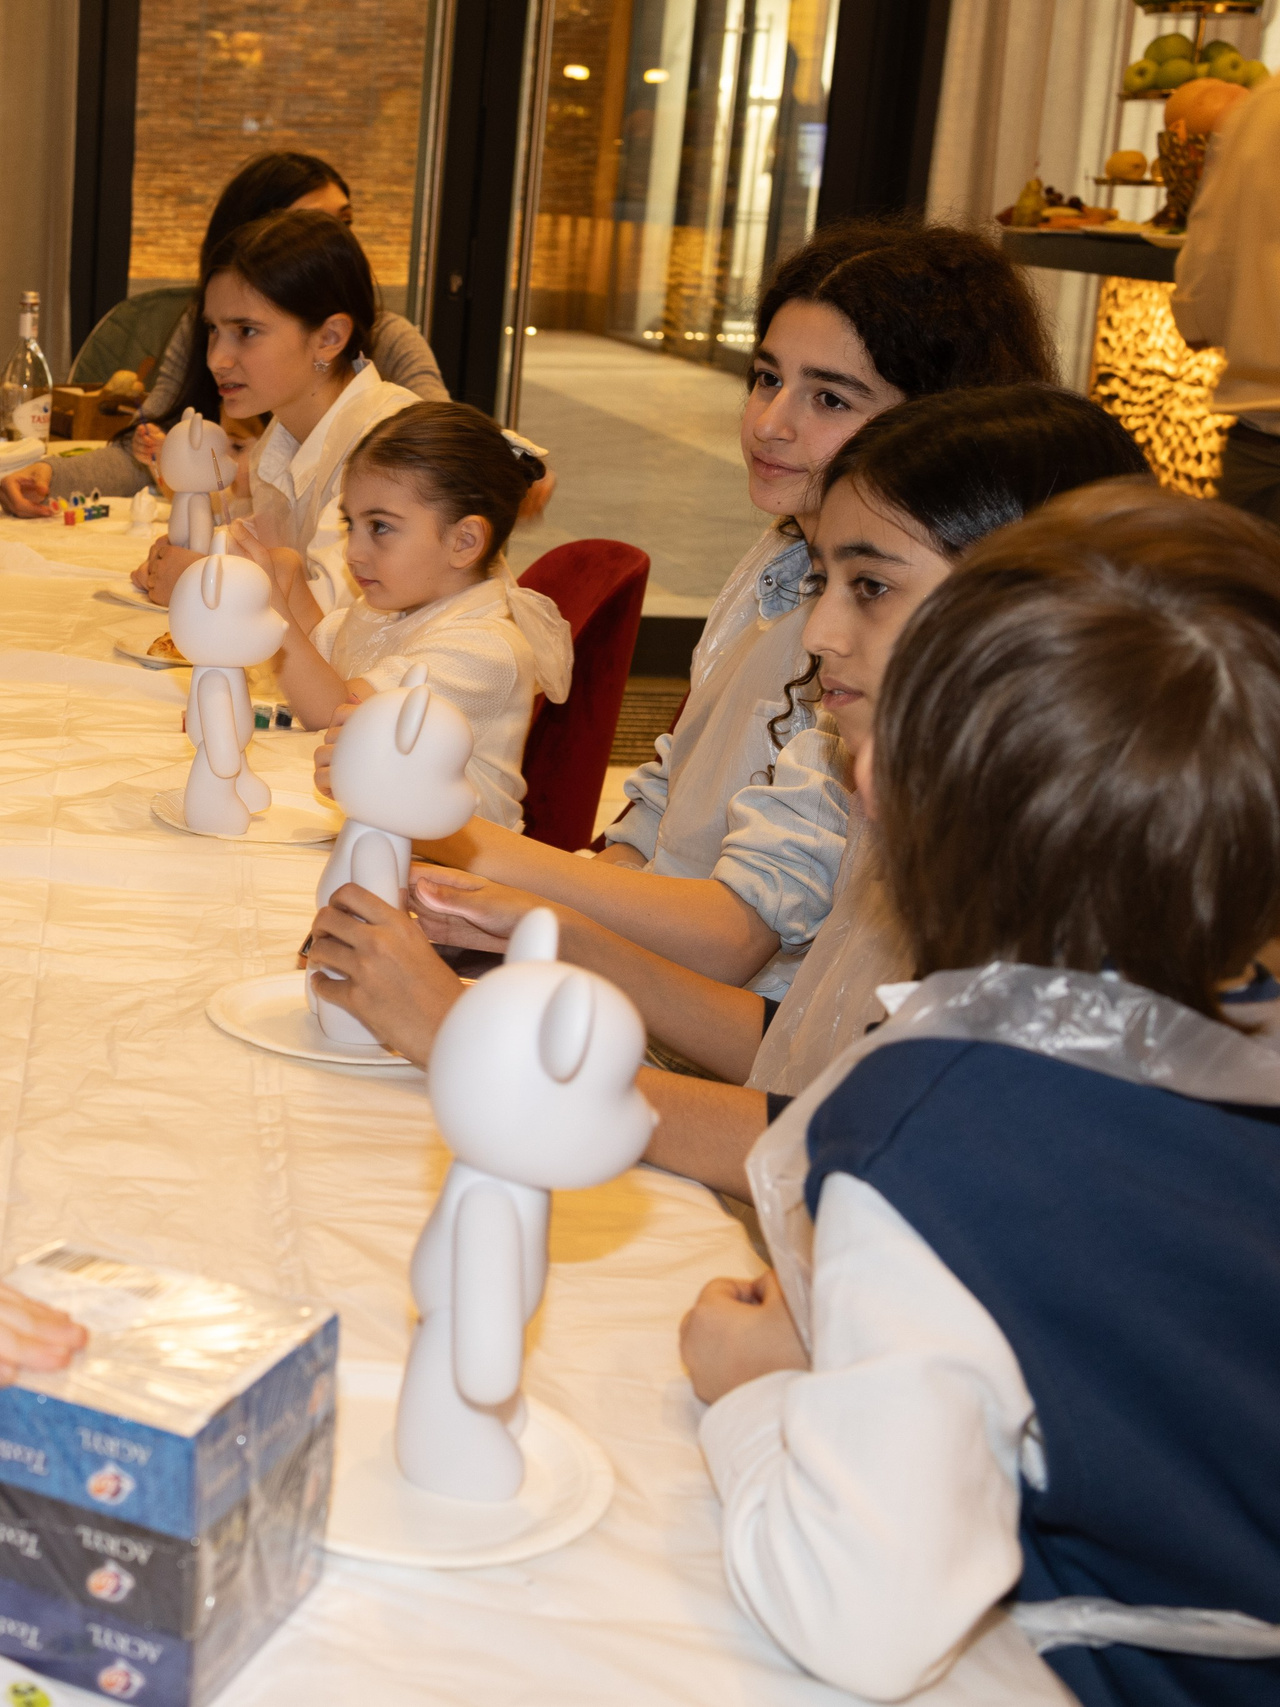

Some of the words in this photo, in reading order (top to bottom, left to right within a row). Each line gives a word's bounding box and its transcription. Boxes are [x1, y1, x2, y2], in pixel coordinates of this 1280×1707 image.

[78, 1427, 152, 1466] ACRYL
[75, 1524, 153, 1566] ACRYL
[85, 1622, 164, 1664] ACRYL
